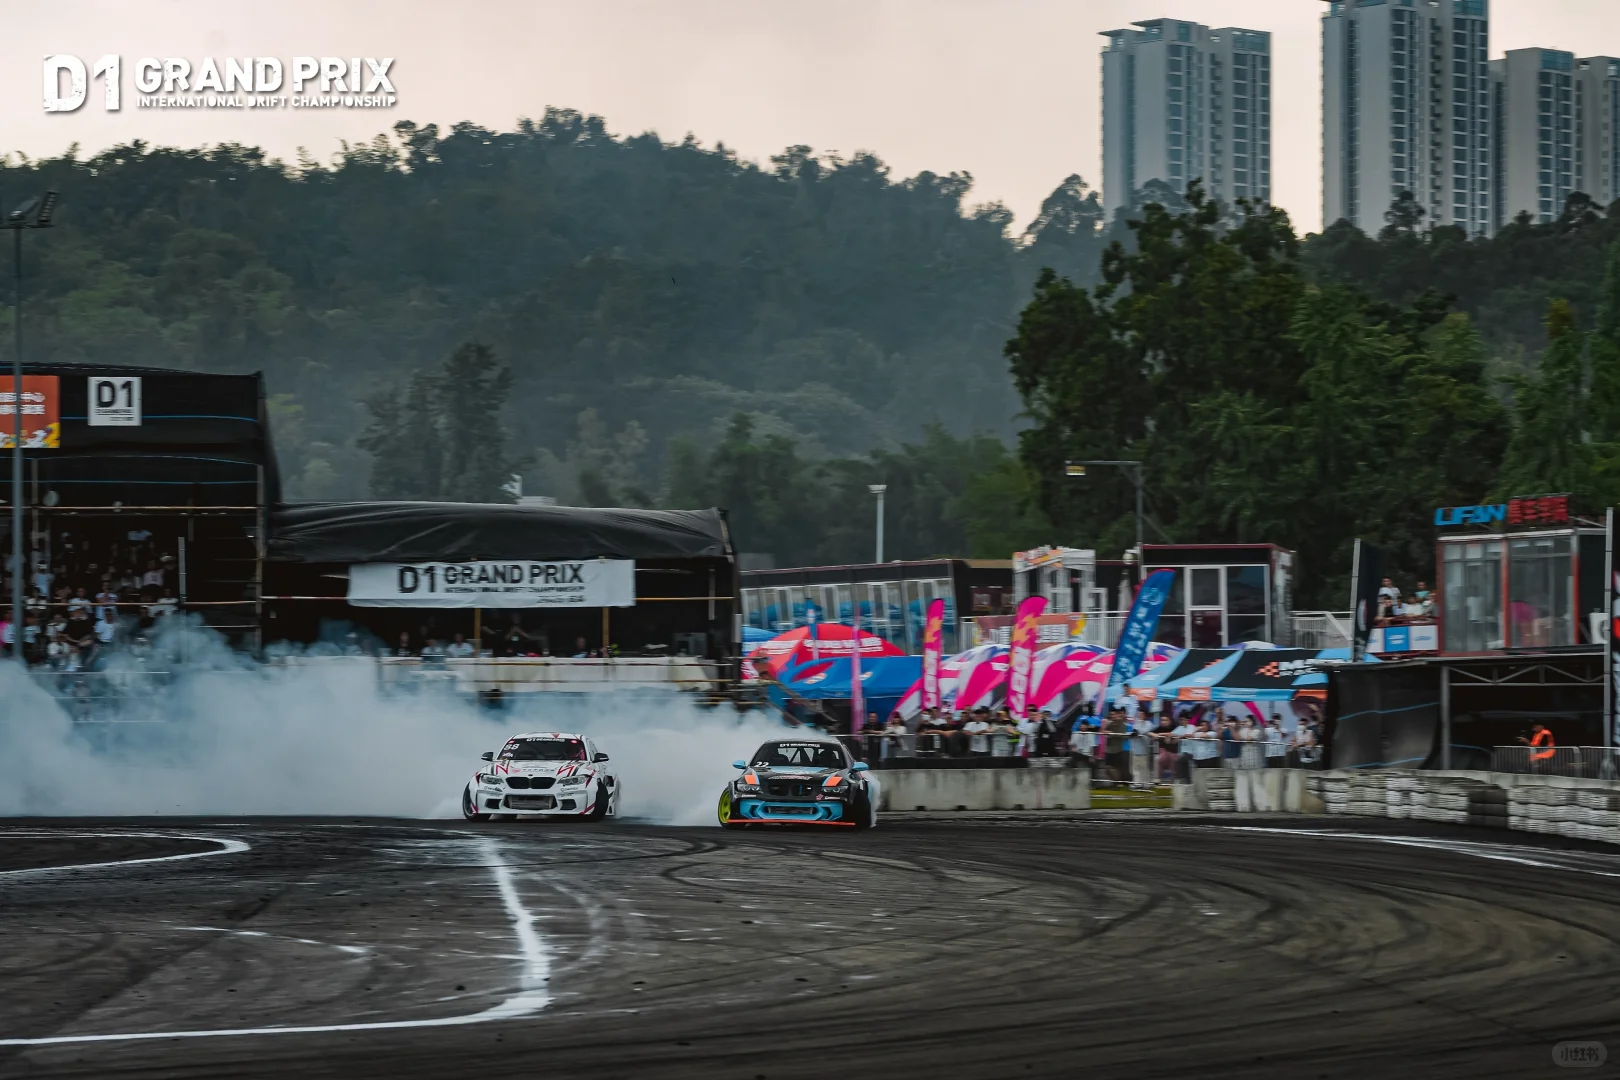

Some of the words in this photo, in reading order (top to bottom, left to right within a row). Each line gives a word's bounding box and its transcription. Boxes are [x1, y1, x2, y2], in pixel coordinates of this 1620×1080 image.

[97, 381, 134, 407] D1
[399, 566, 436, 593] D1
[445, 564, 523, 584] GRAND
[529, 564, 584, 583] PRIX
